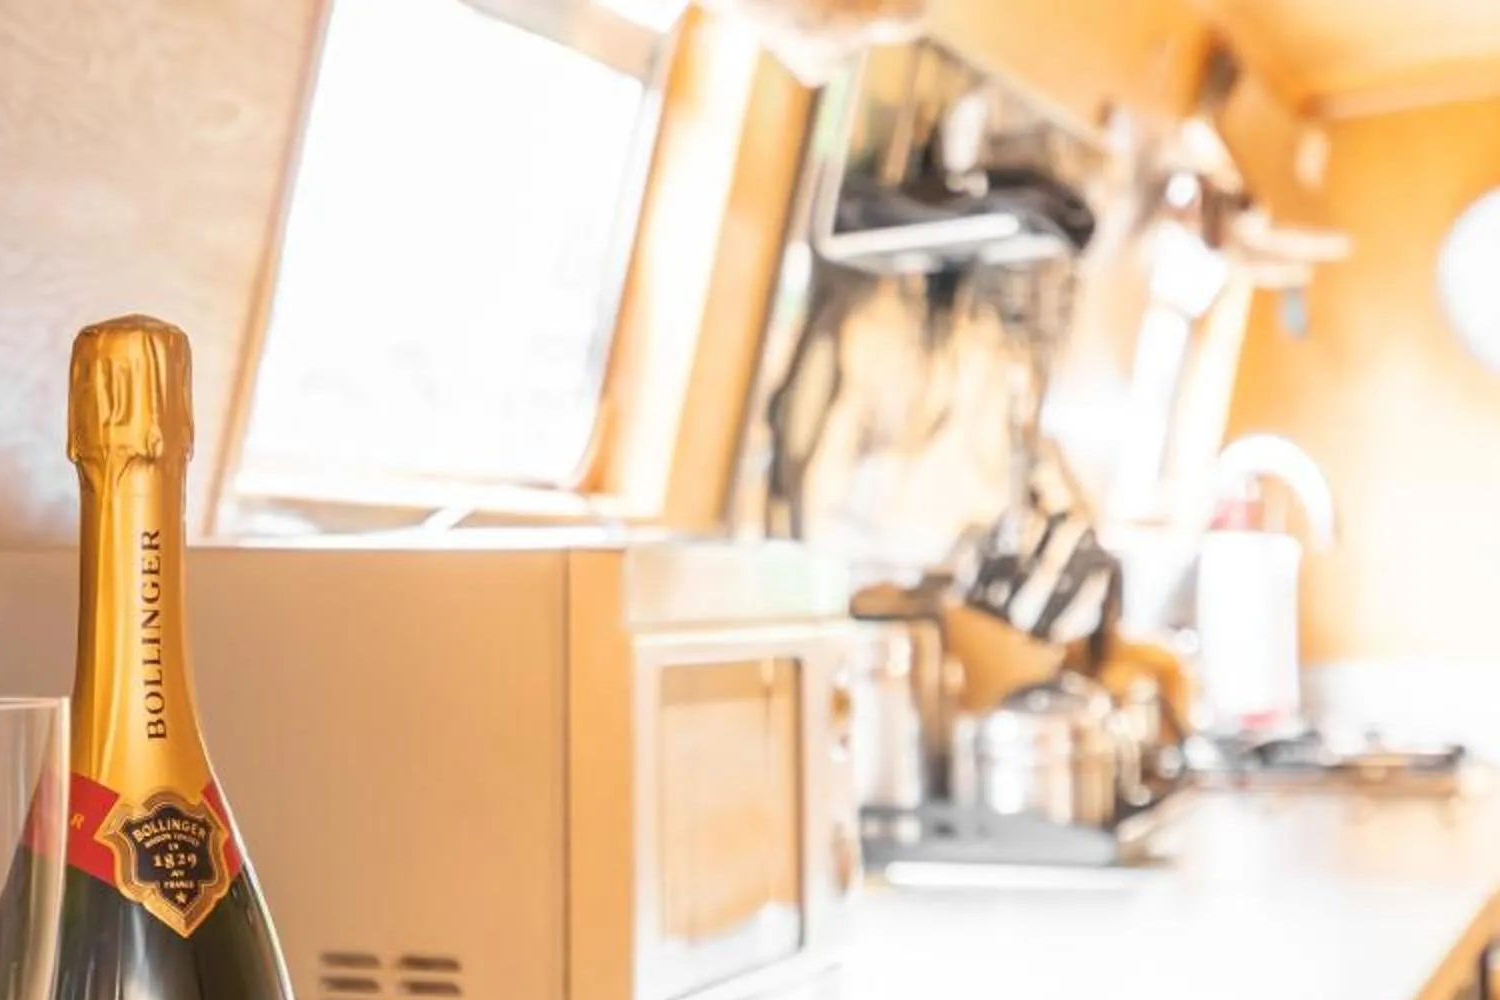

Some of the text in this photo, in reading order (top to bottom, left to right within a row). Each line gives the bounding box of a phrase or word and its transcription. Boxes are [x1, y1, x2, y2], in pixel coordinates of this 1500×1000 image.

[139, 529, 168, 740] BOLLINGER
[132, 818, 207, 843] BOLLINGER
[153, 852, 198, 869] 1829
